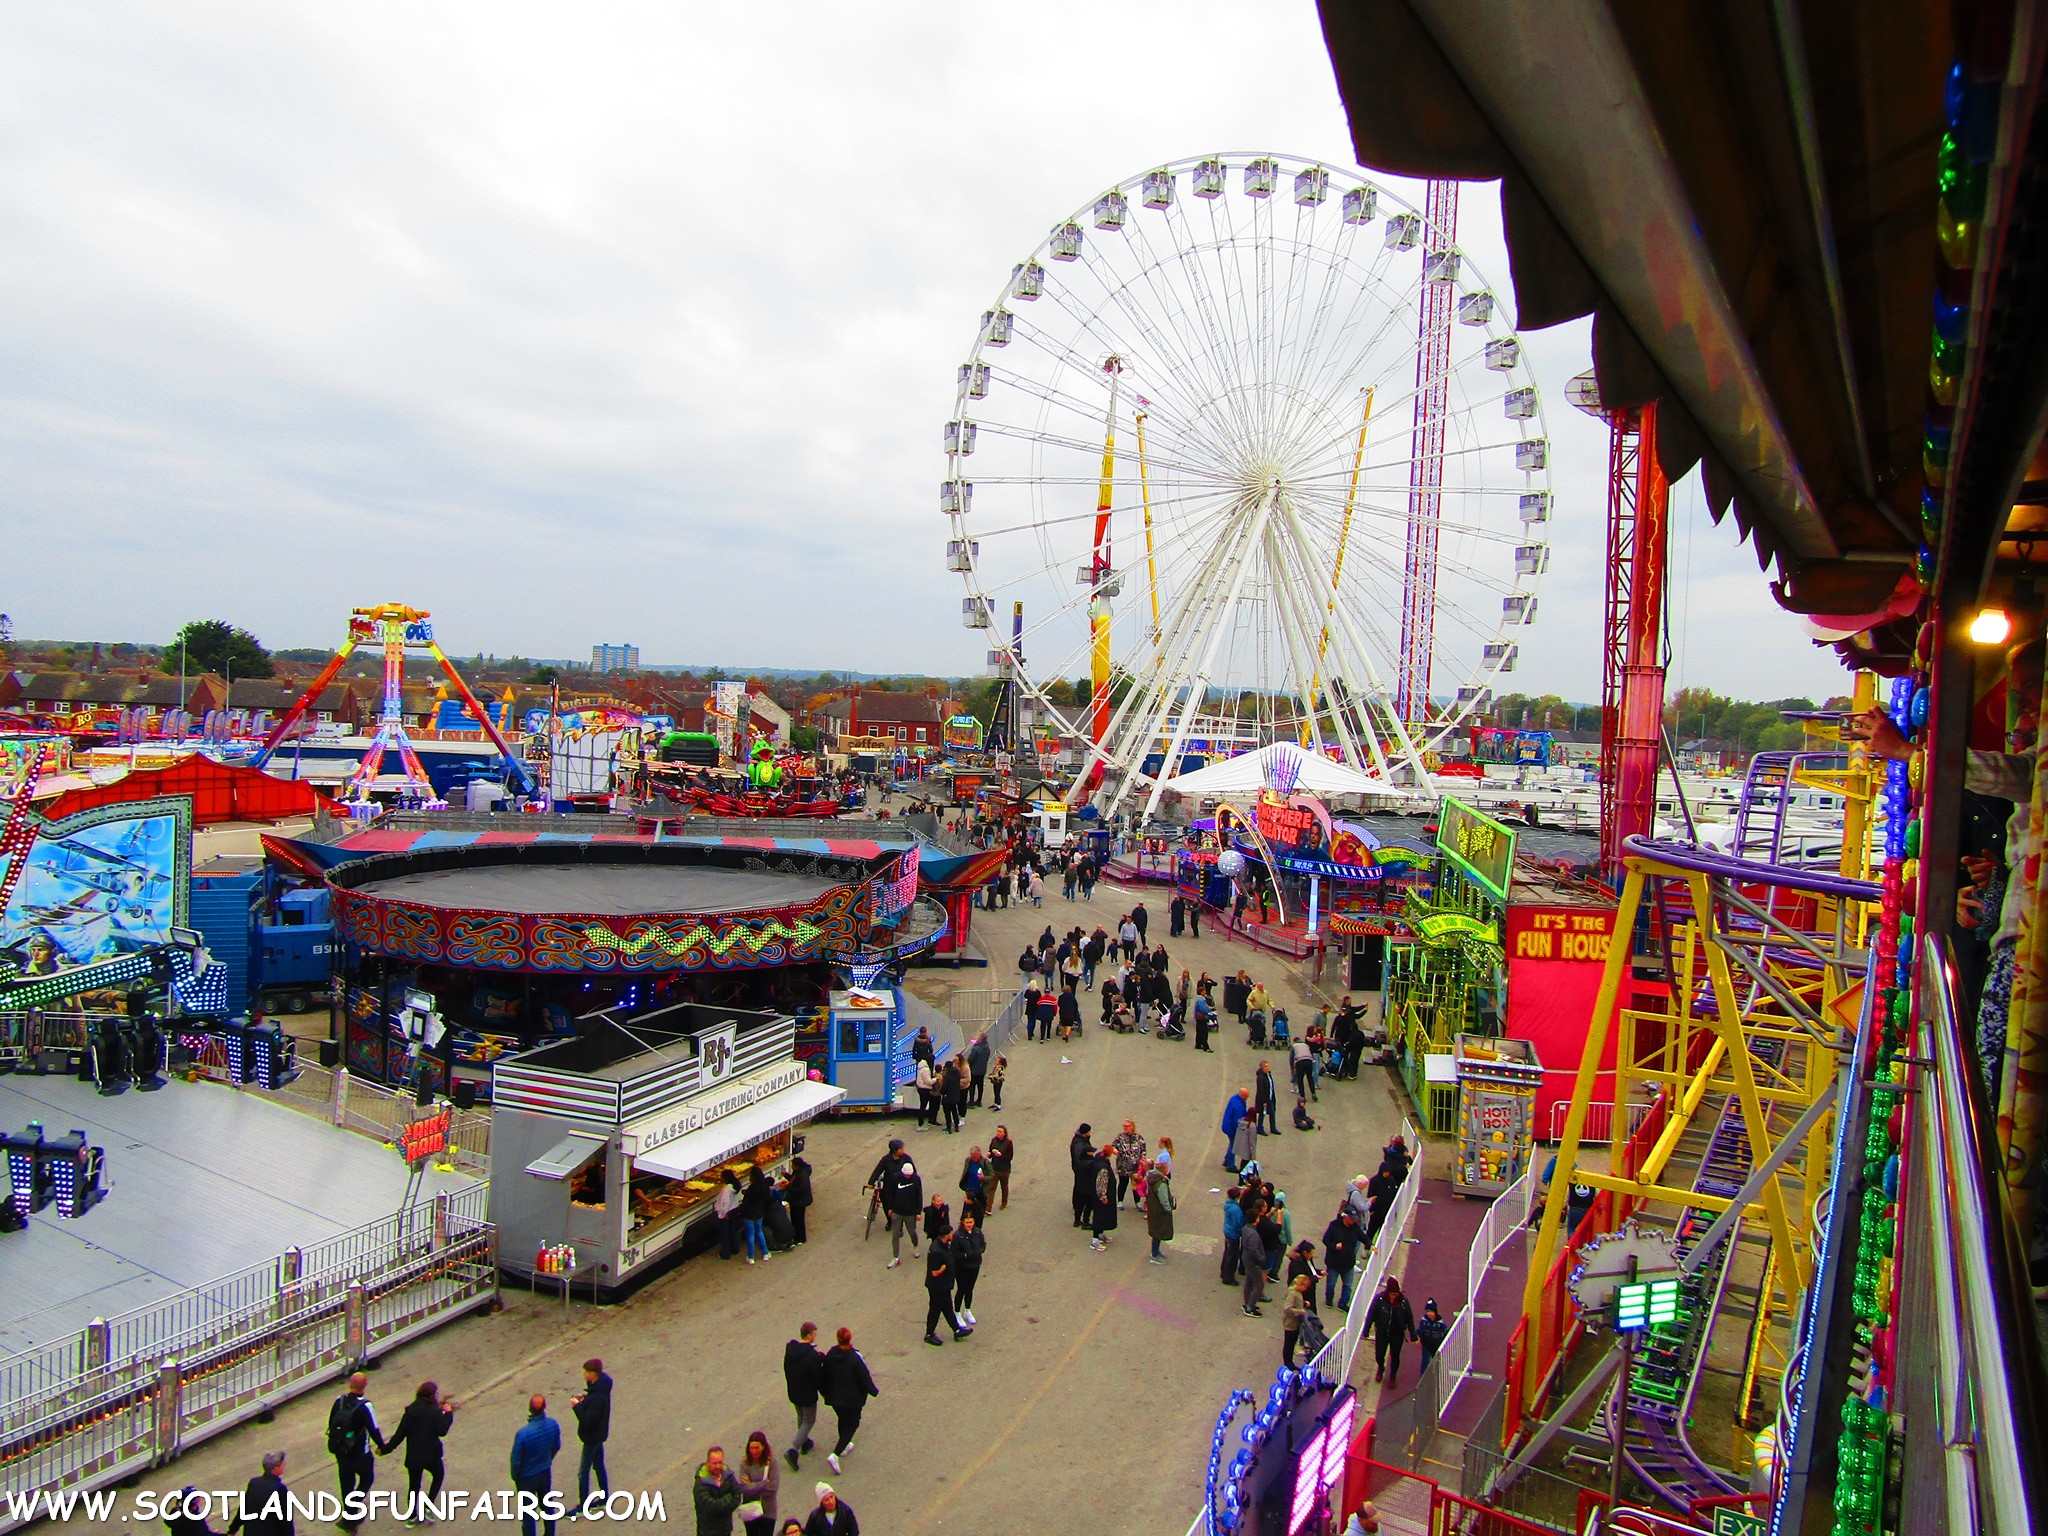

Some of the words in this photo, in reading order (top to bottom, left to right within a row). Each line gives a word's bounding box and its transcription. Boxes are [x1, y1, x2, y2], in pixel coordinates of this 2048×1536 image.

[847, 738, 886, 748] coffee
[1534, 914, 1568, 929] IT'S
[1571, 915, 1606, 931] THE
[1517, 931, 1552, 958] FUN
[1561, 932, 1612, 960] HOUS
[644, 1114, 698, 1149] CLASSIC
[704, 1089, 754, 1122] CATERING
[756, 1067, 802, 1098] COMPANY
[413, 1115, 441, 1141] AIR
[1483, 1119, 1511, 1129] BOX
[406, 1132, 445, 1163] RAID
[708, 1155, 724, 1168] FOR
[726, 1146, 740, 1160] ALL
[741, 1135, 761, 1151] YOUR
[783, 1111, 814, 1131] CATERING
[1719, 1515, 1766, 1536] EXI
